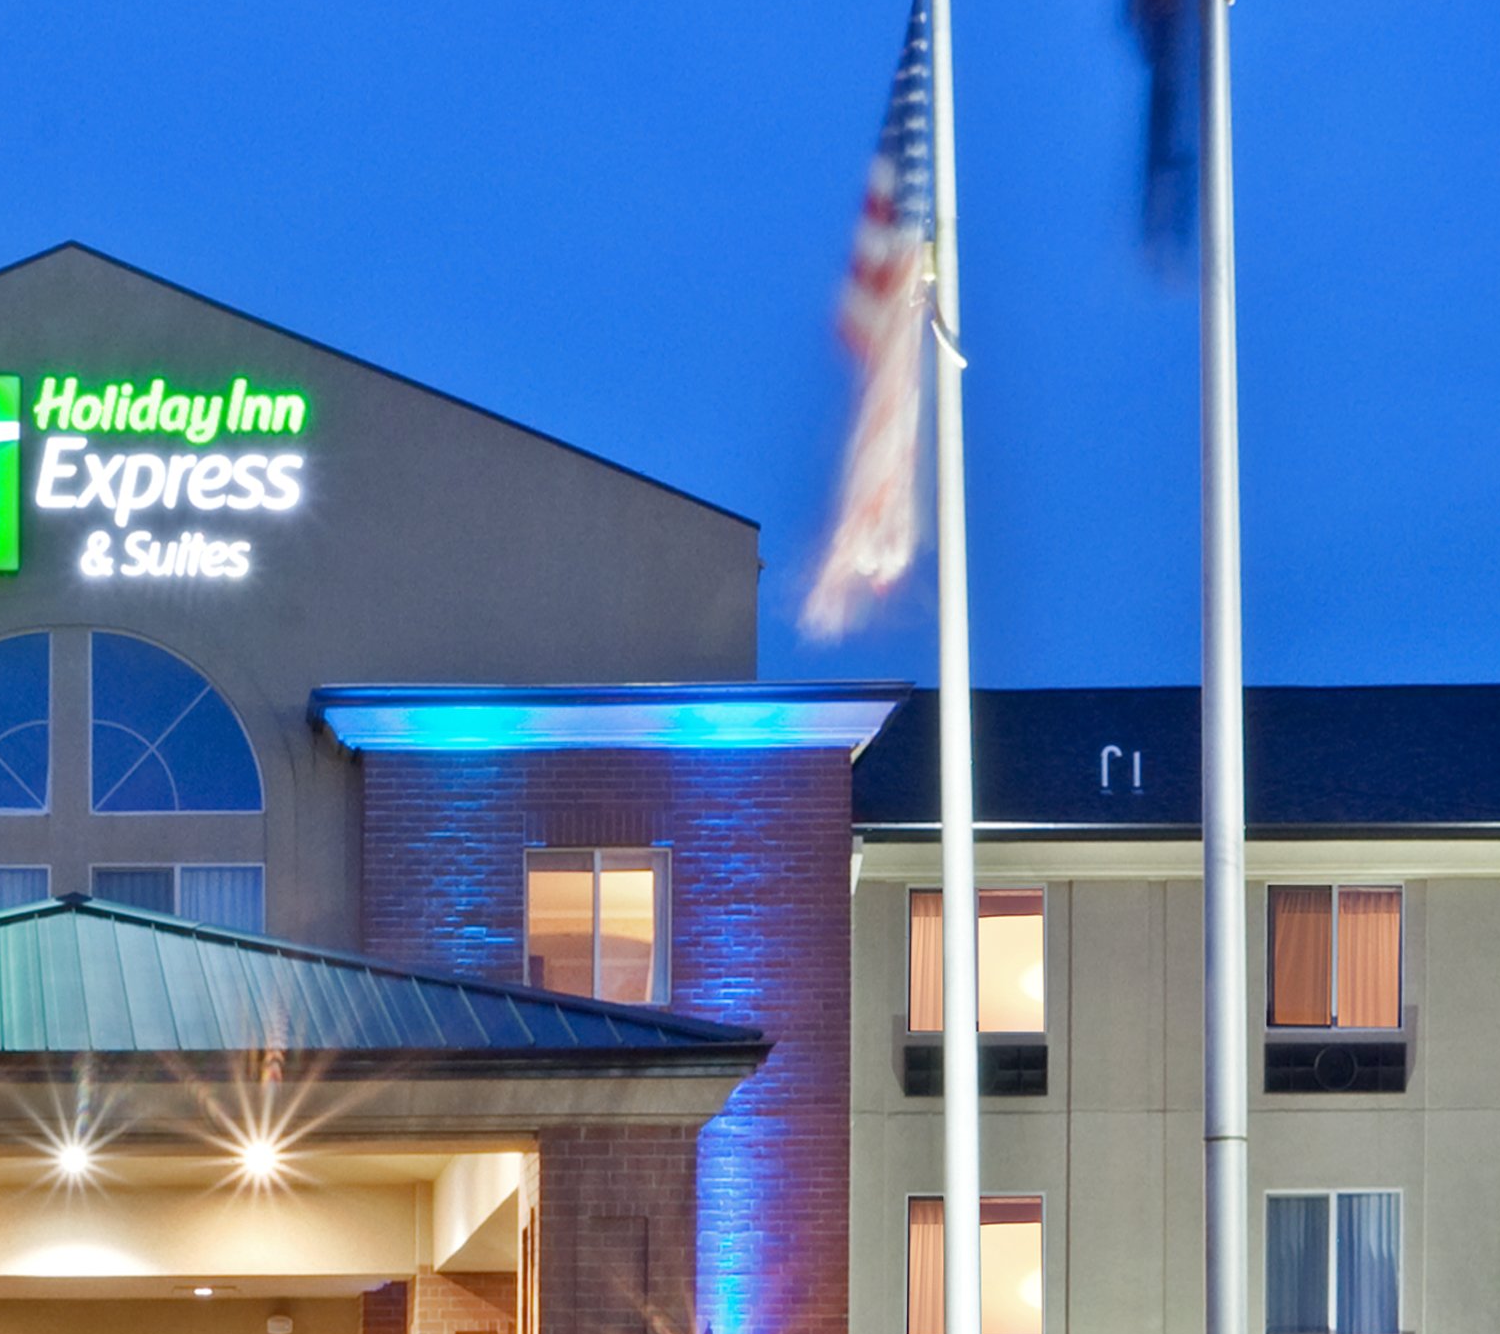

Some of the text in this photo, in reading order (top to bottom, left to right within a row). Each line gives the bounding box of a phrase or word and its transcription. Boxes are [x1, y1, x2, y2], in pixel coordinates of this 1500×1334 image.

[33, 377, 305, 443] Holiday Inn
[35, 436, 303, 527] Express
[80, 531, 251, 578] & Suites
